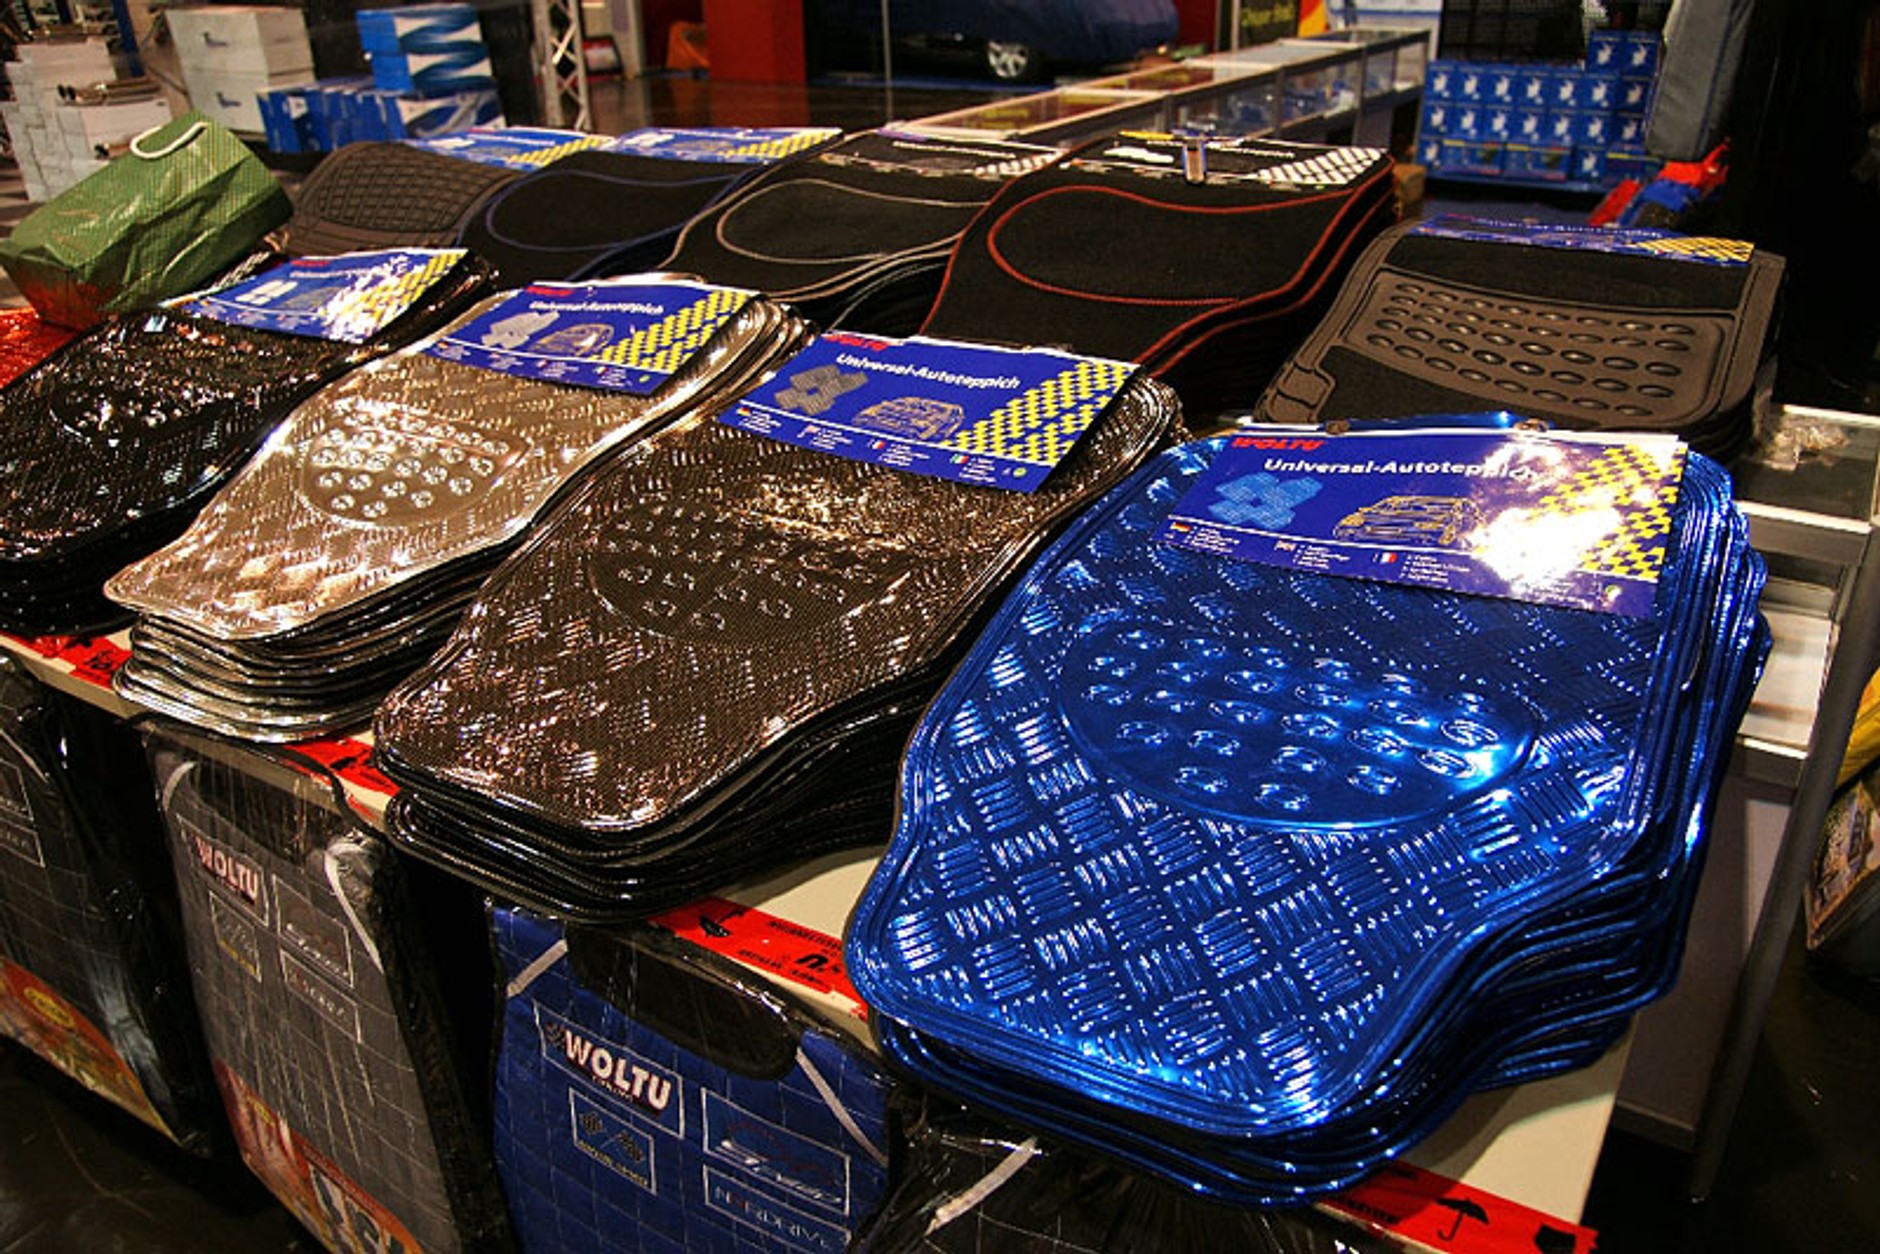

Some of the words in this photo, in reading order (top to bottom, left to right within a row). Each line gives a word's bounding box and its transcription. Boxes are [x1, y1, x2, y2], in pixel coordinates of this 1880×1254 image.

[836, 352, 1021, 389] Universal-Autoteppich
[1231, 437, 1324, 451] WOLTU
[194, 835, 260, 900] WOLTU
[564, 1030, 672, 1111] WOLTU
